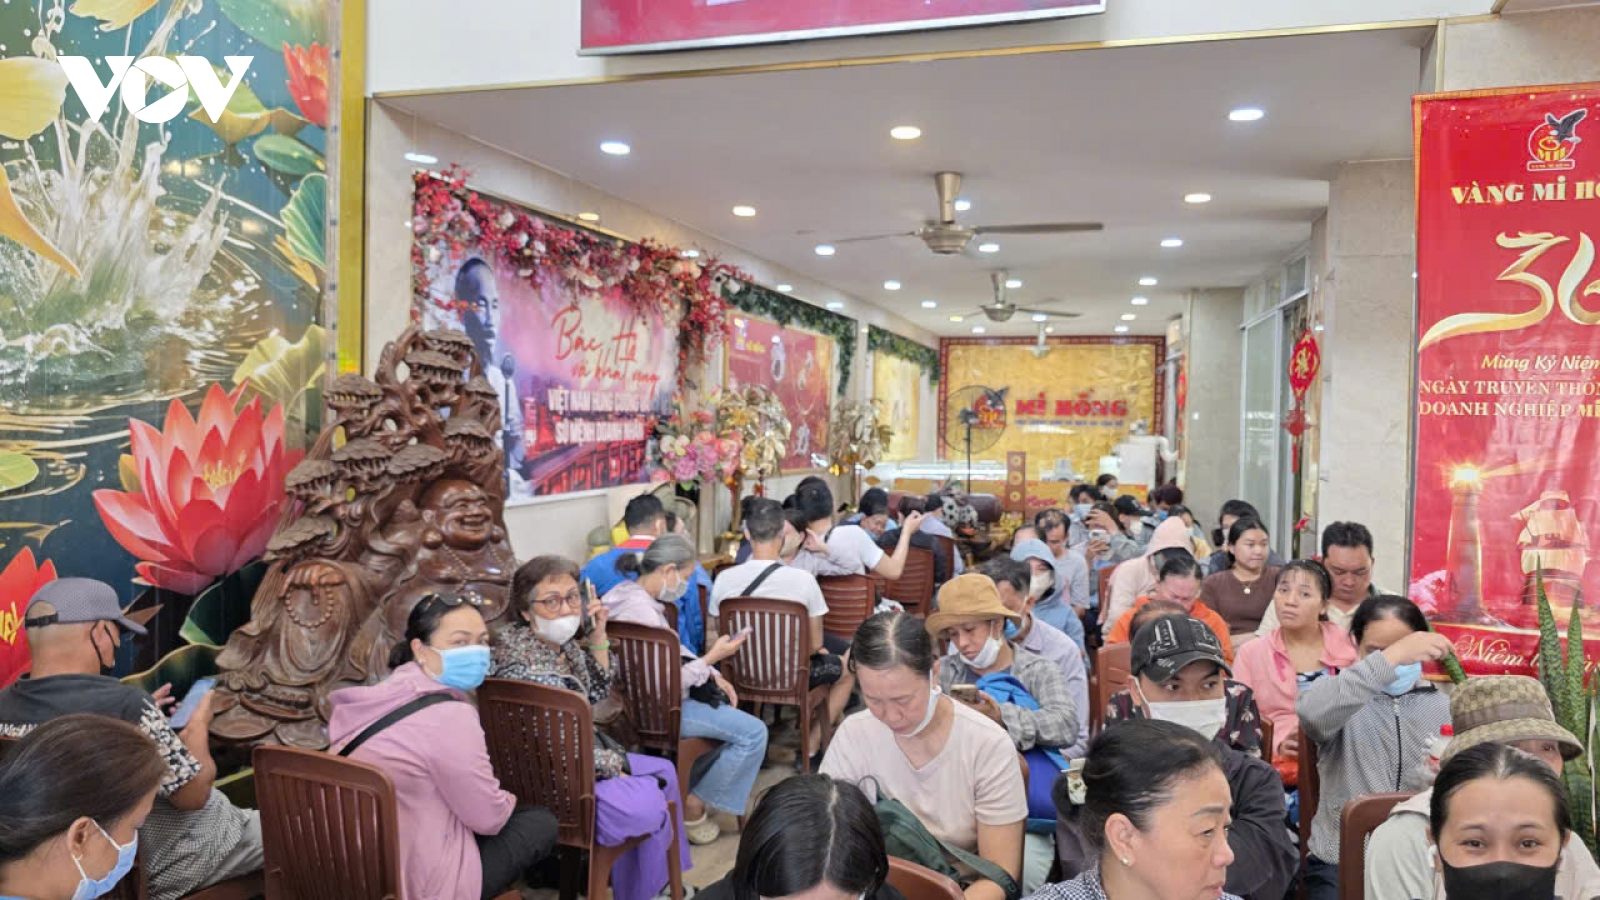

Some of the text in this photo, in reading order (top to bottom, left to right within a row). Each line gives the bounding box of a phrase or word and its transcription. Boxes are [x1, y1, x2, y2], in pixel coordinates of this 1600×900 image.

[1450, 181, 1525, 204] VÀNG
[1419, 375, 1470, 396] NGÀY
[1419, 401, 1488, 417] DOANH
